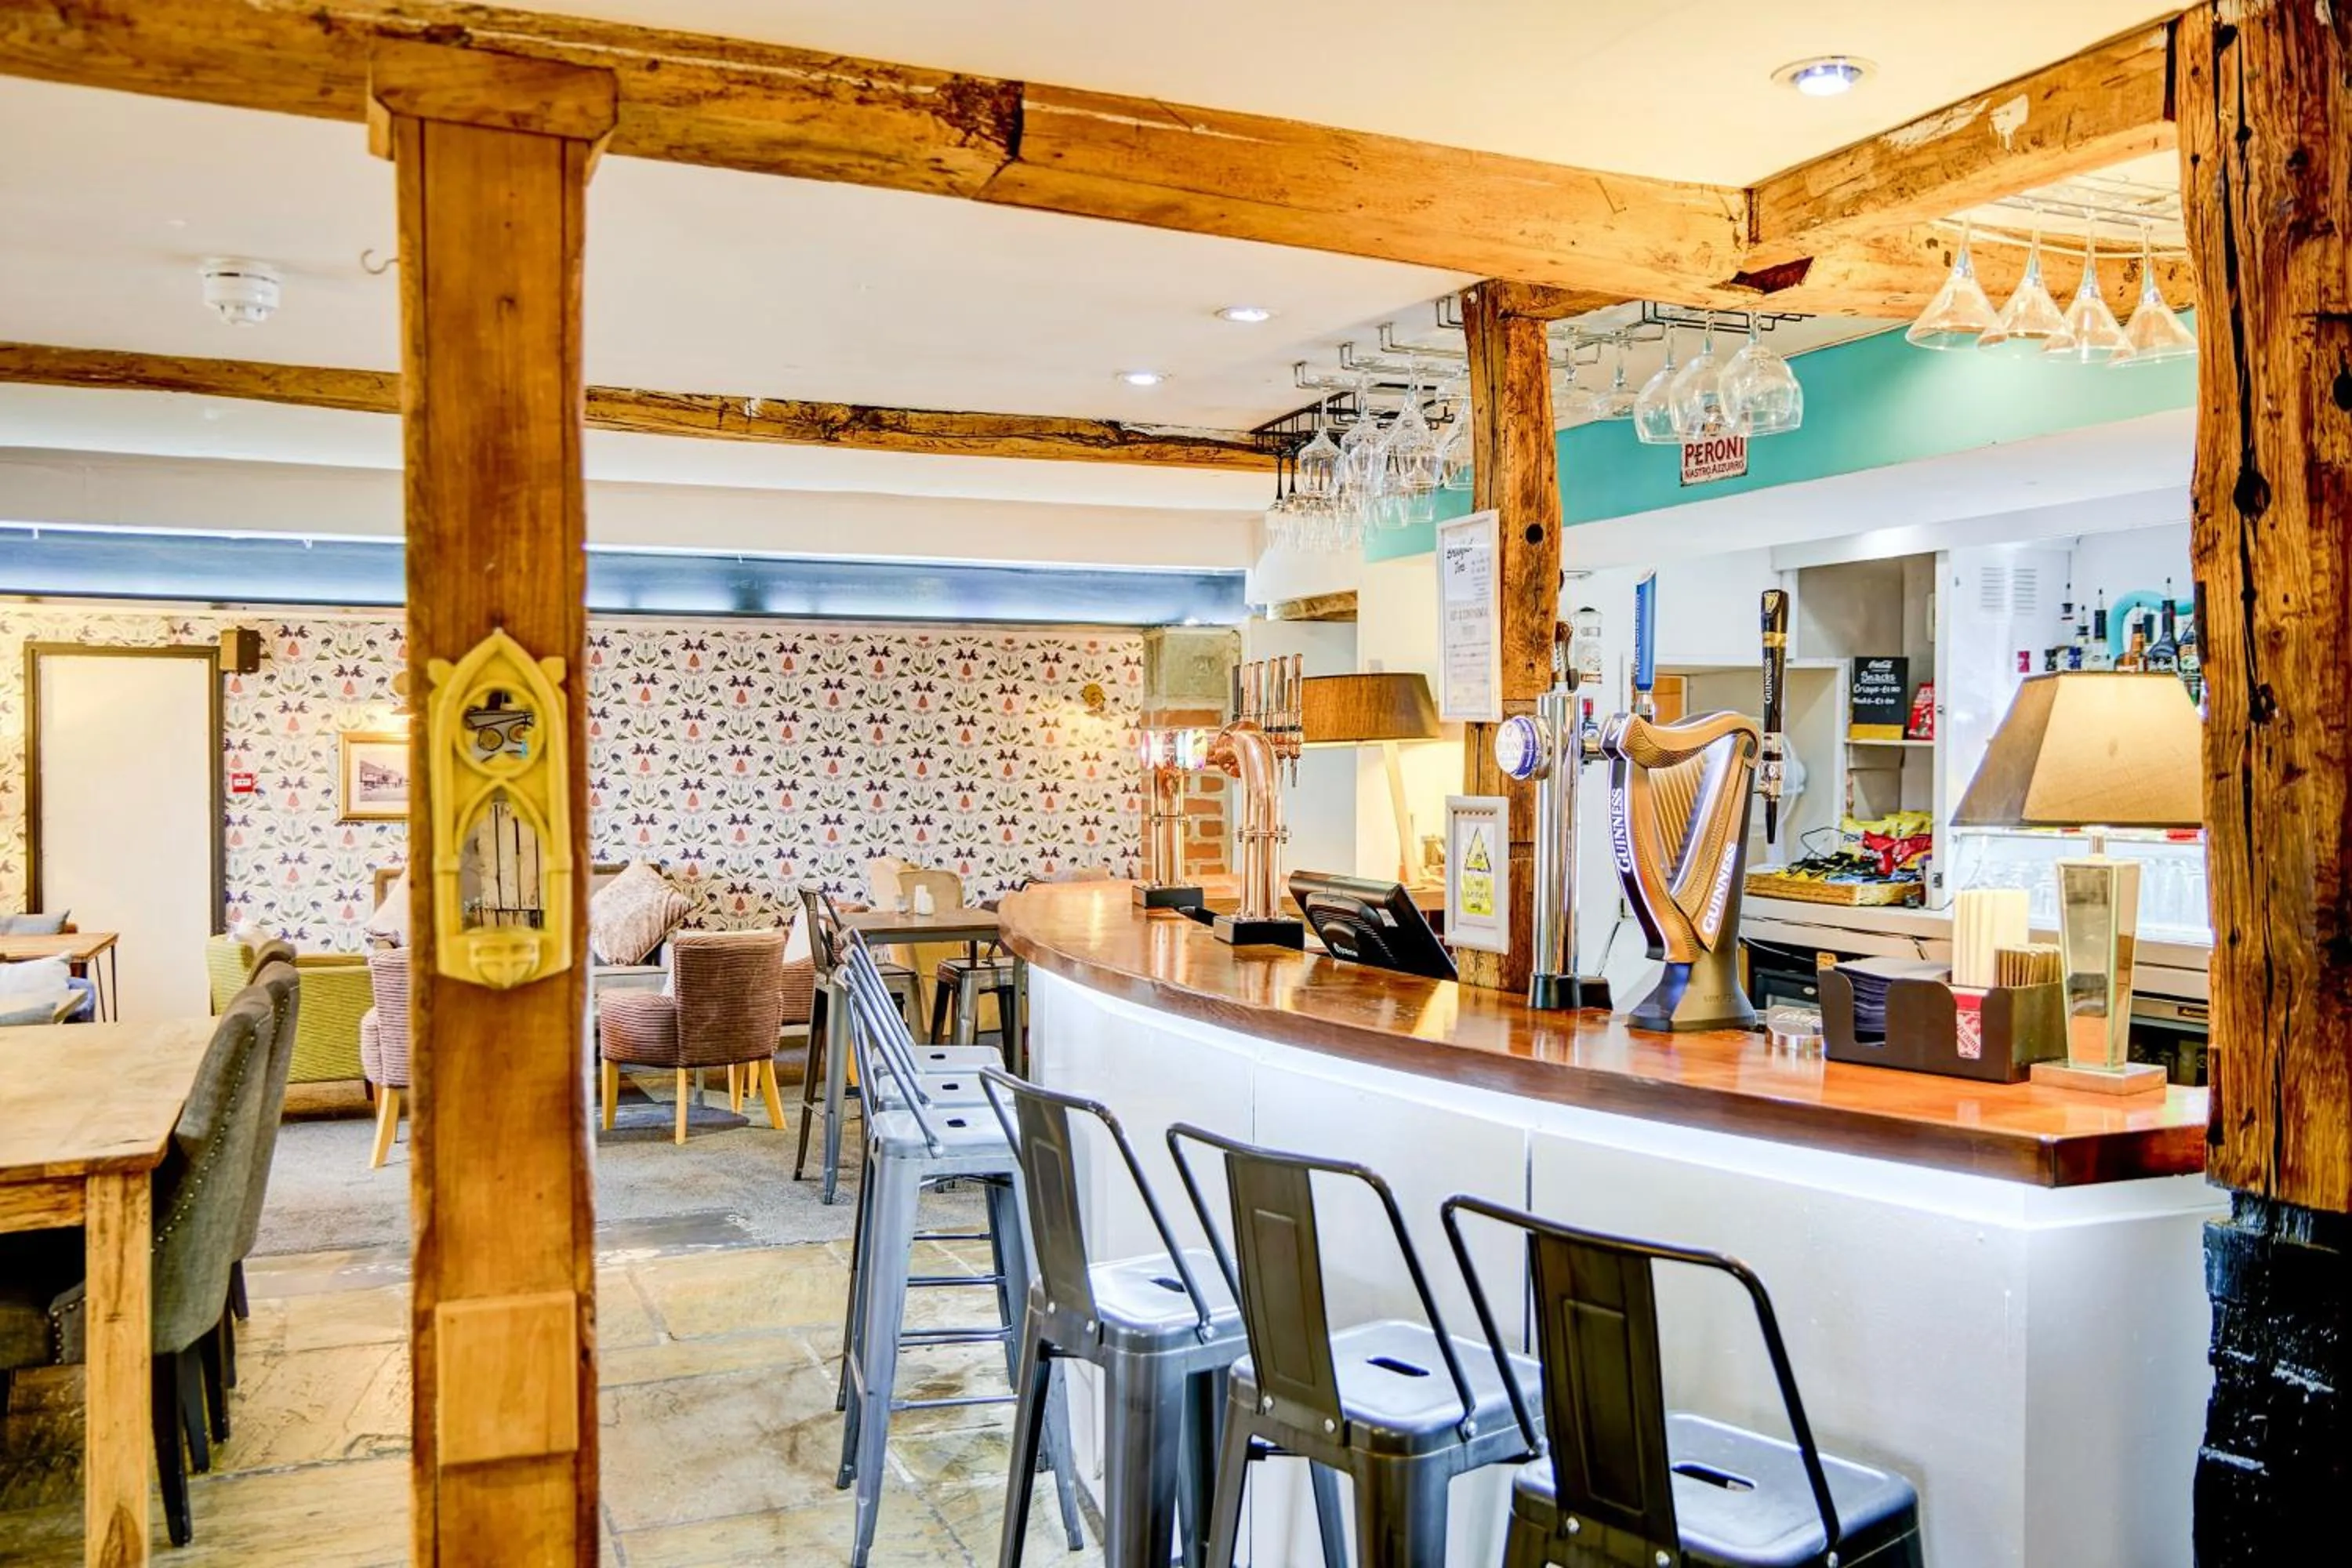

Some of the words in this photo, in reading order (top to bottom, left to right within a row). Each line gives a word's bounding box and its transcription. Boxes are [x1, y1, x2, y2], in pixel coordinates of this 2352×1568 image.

[1685, 436, 1744, 467] PERONI
[1685, 466, 1711, 478] NASTRO
[1712, 461, 1744, 474] AZZURRO
[1764, 658, 1773, 705] GUINNESS
[1611, 787, 1632, 873] GUINNESS
[1702, 840, 1737, 934] GUINNESS
